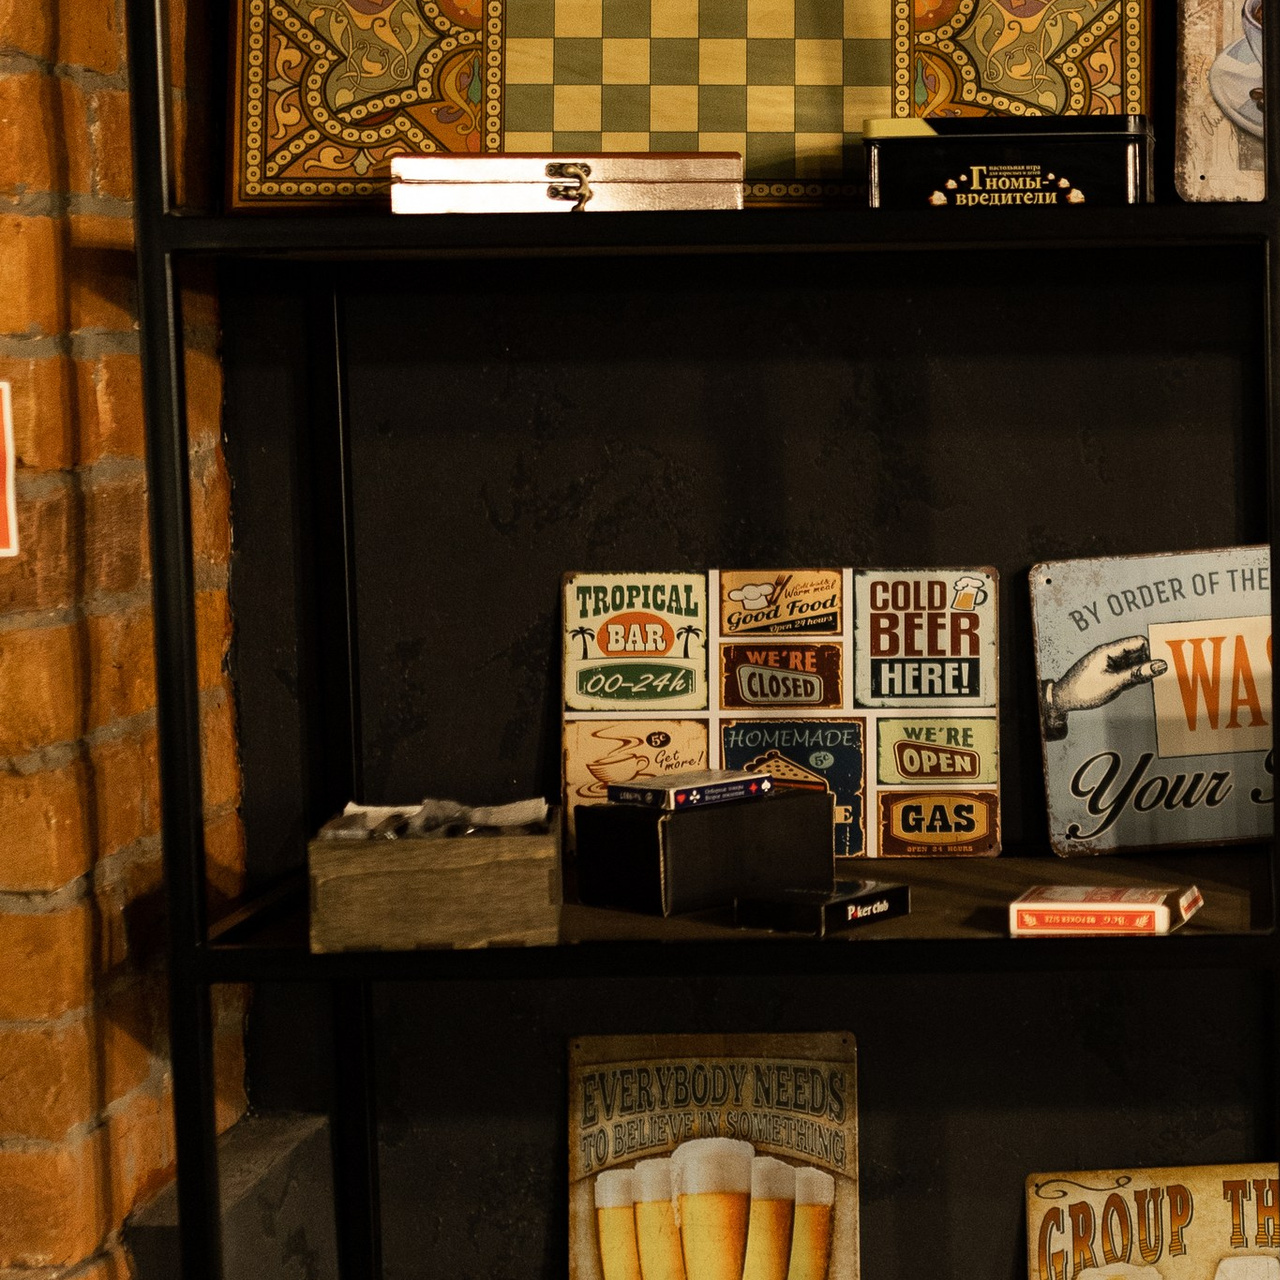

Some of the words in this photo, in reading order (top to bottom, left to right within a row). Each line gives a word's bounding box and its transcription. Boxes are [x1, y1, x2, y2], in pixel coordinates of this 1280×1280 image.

[970, 166, 1050, 190] Гномы-
[955, 191, 1058, 206] вредители
[576, 584, 699, 619] TROPICAL
[870, 581, 947, 611] COLD
[1069, 602, 1101, 632] BY
[1107, 578, 1186, 617] ORDER
[1193, 572, 1221, 597] OF
[1227, 567, 1270, 593] THE
[727, 605, 782, 631] Good
[787, 594, 838, 616] Food
[769, 622, 793, 633] Open
[807, 615, 833, 626] hours
[607, 623, 667, 652] BAR
[870, 613, 980, 657] BEER
[746, 651, 818, 673] WE'RE
[747, 672, 816, 698] CLOSED
[881, 663, 970, 695] HERE!
[729, 728, 855, 748] HOMEMADE
[903, 726, 974, 748] WE'RE
[655, 749, 680, 770] Get
[665, 751, 704, 771] more!
[903, 748, 972, 773] OPEN
[1069, 750, 1233, 841] Your
[901, 804, 976, 833] GAS
[580, 1063, 747, 1129] EVERYBODY
[752, 1064, 847, 1124] NEEDS
[580, 1127, 609, 1172] TO
[612, 1111, 694, 1159] BELIEVE
[697, 1110, 722, 1140] IN
[725, 1111, 846, 1170] SOMETHING
